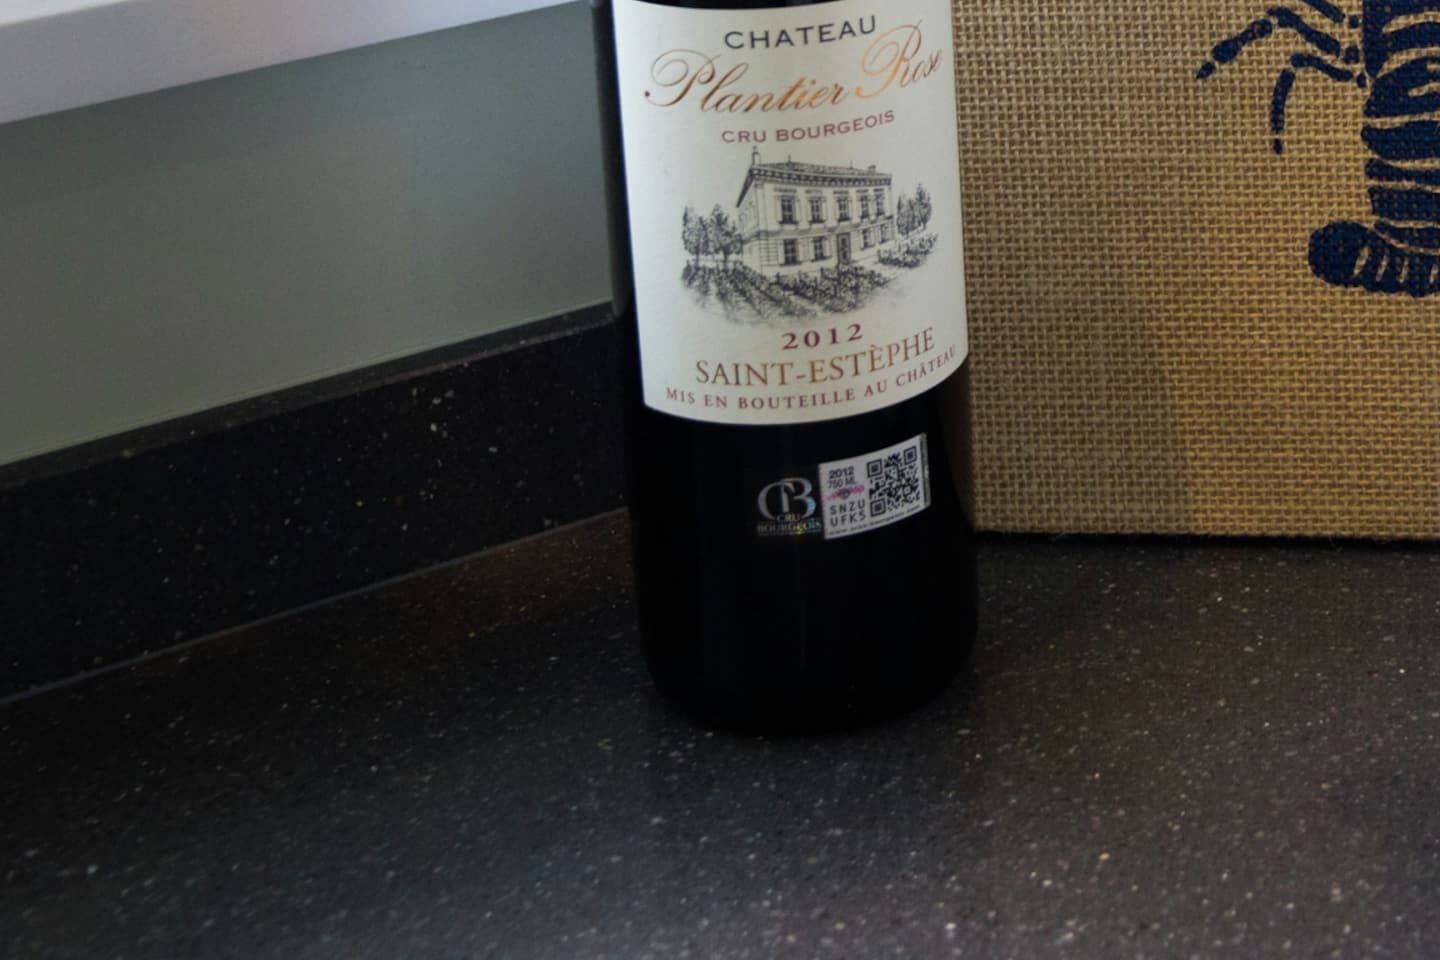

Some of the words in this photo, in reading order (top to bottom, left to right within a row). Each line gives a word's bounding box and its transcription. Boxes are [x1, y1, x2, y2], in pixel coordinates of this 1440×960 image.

[724, 14, 877, 50] CHATEAU
[644, 48, 849, 114] Plantier
[721, 129, 767, 145] CRU
[776, 109, 896, 142] BOURGEOIS
[782, 323, 863, 351] 2012
[695, 326, 935, 387] SAINT-ESTÈPHE
[666, 386, 696, 405] MIS
[704, 394, 728, 409] EN
[737, 387, 855, 410] BOUTEILLE
[863, 380, 888, 398] AU
[828, 465, 855, 480] 2012
